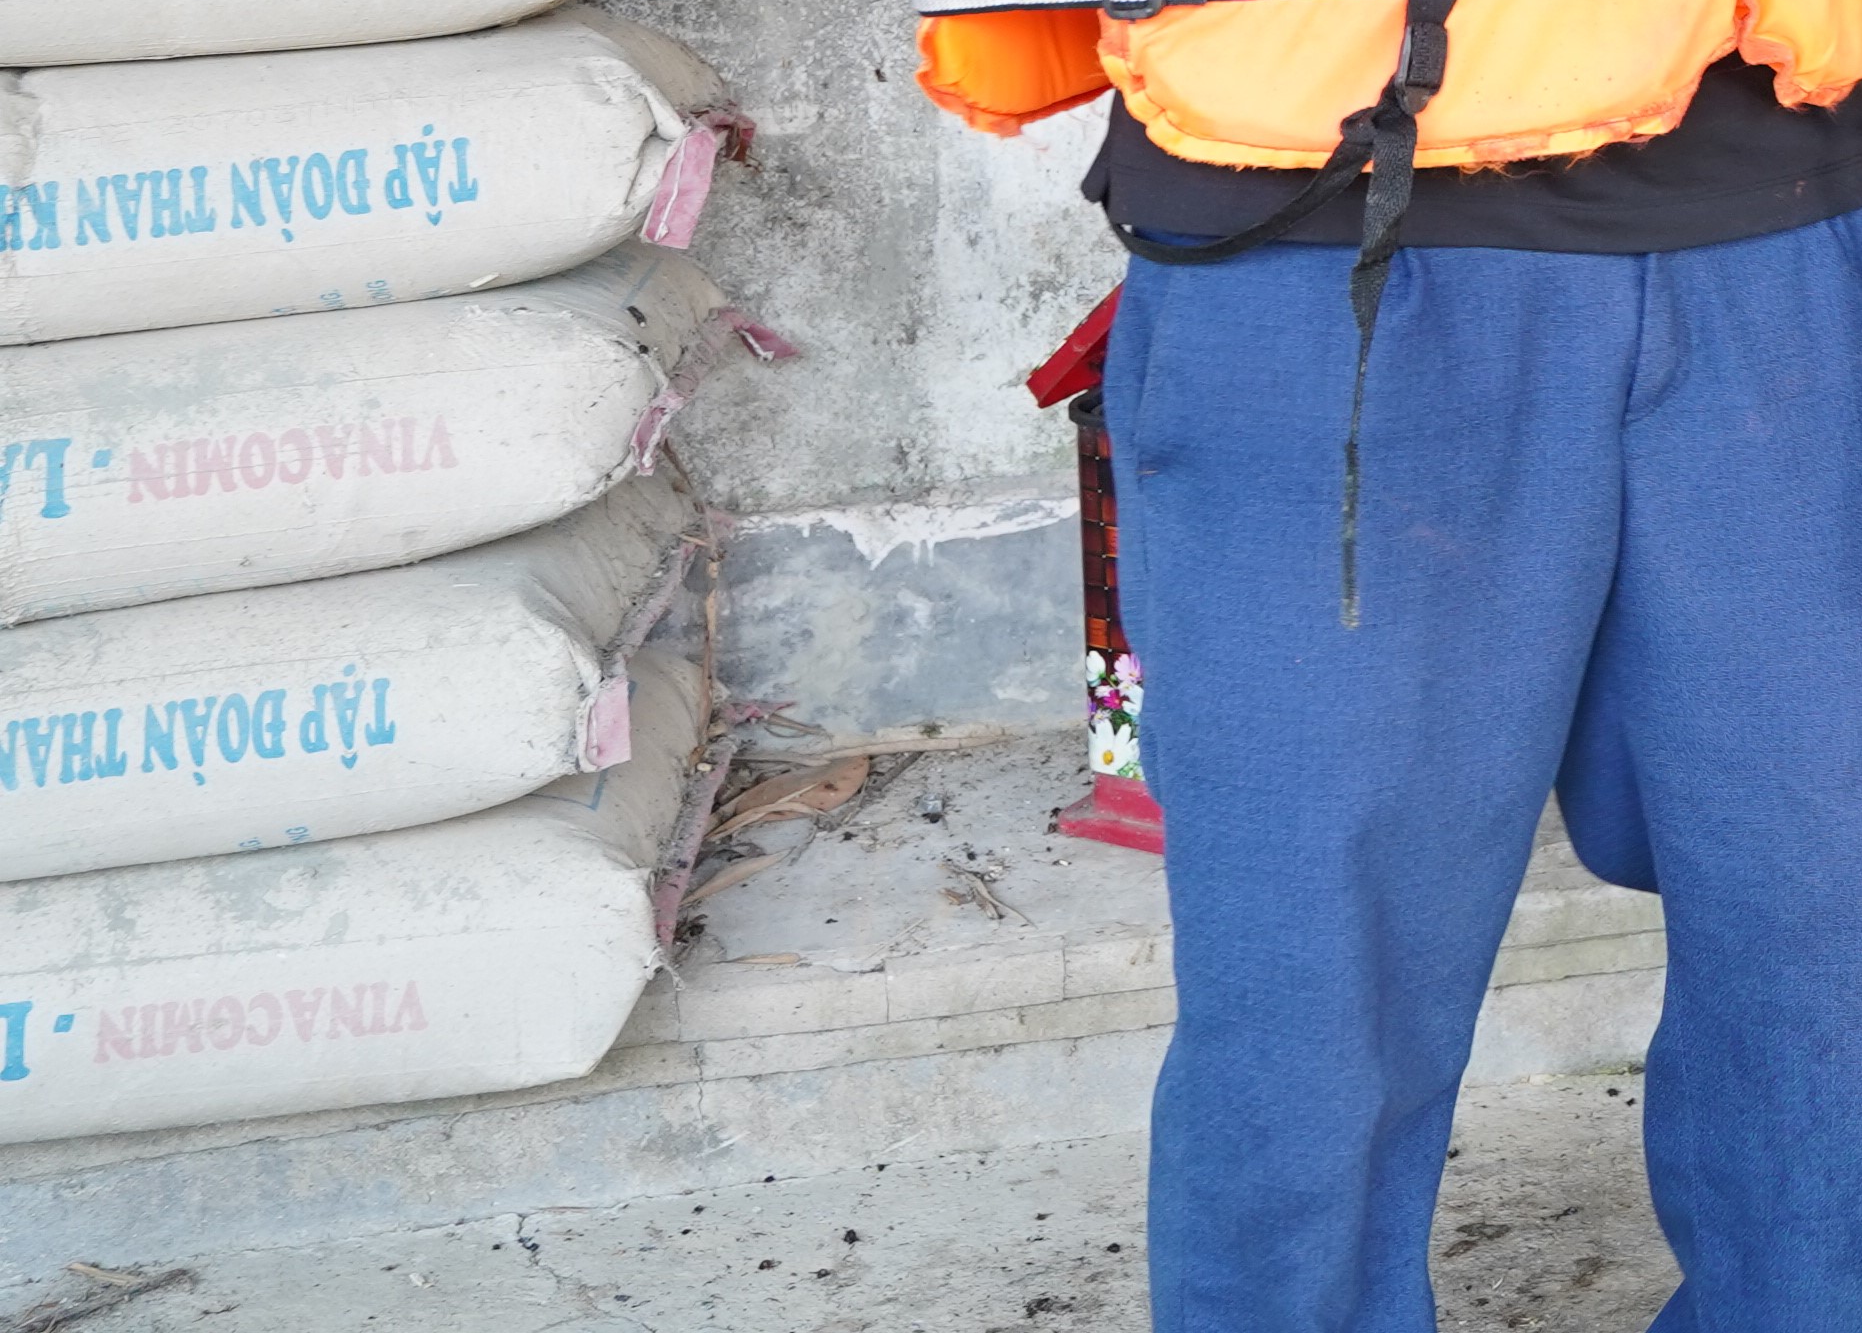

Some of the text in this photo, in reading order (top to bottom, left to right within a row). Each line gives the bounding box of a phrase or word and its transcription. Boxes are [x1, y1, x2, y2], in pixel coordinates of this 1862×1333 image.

[75, 164, 216, 247] THAN
[230, 148, 372, 242] ĐOÀN
[384, 123, 480, 227] TẬP
[126, 415, 459, 505] VINACOMIN
[143, 686, 288, 786] ĐOÀN
[309, 663, 397, 771] TẬP
[93, 980, 429, 1065] VINACOMIN
